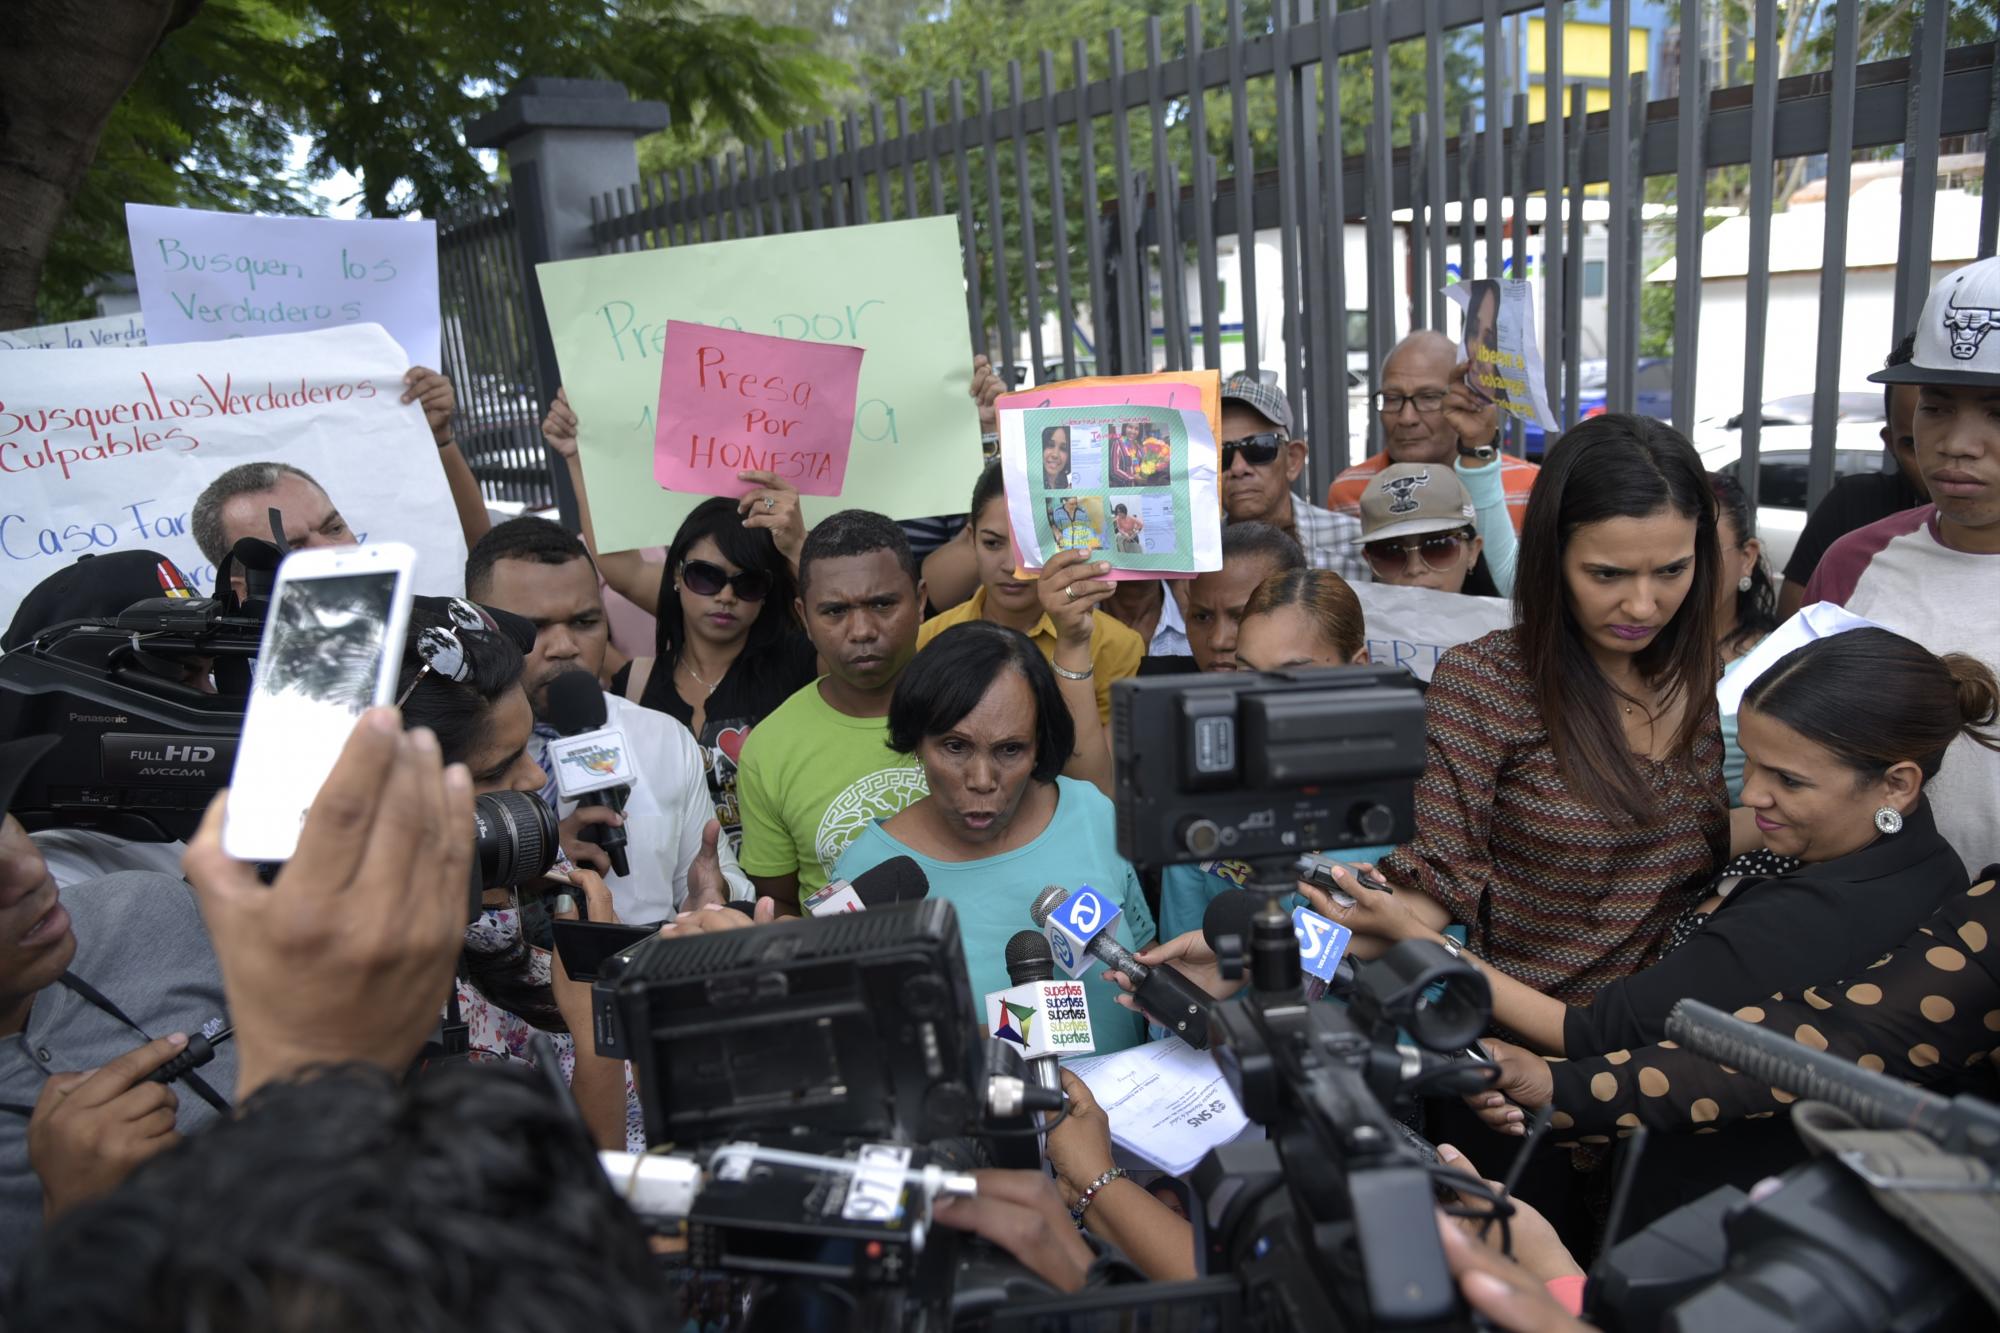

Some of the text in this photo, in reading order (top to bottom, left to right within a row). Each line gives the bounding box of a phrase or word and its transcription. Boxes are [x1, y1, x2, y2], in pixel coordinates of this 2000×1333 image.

[158, 238, 397, 291] Busquen los
[171, 291, 361, 323] Verdaderos
[197, 372, 376, 415] Verdaderos
[695, 346, 812, 408] Presa
[743, 408, 804, 437] Por
[0, 426, 199, 480] Culpables
[689, 434, 832, 480] HONESTA
[0, 514, 118, 560] Caso
[69, 712, 128, 724] Panasonic
[130, 745, 216, 763] FULL HD
[137, 767, 206, 777] AVCCAM
[1187, 1109, 1213, 1128] SNS
